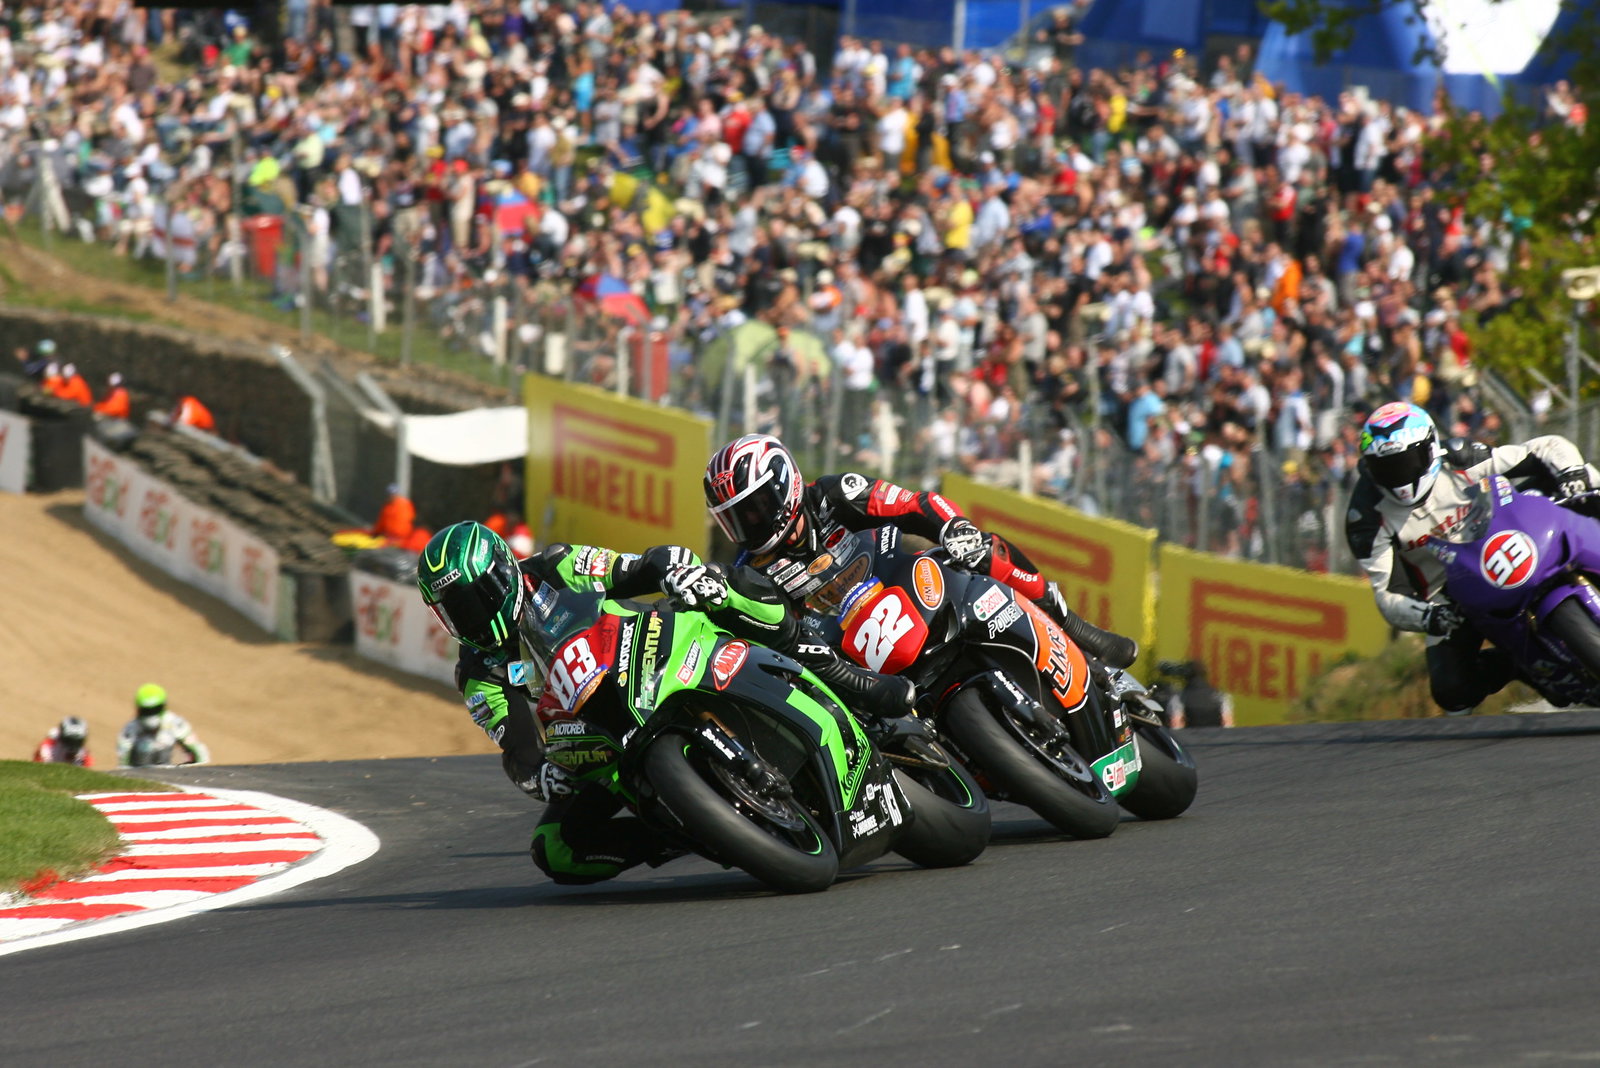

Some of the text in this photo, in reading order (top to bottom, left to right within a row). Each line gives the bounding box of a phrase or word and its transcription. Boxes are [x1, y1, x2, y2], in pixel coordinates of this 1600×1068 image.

[553, 401, 677, 533] PIRELLI
[880, 525, 891, 555] HITACHI
[1485, 531, 1532, 587] 33
[431, 569, 460, 590] SHARK
[981, 591, 1005, 614] Castrol
[618, 622, 635, 673] MOTOREX
[797, 643, 831, 655] TCX
[853, 594, 915, 674] 22
[1188, 577, 1347, 700] PIREL
[640, 616, 664, 711] MOMENTUM
[555, 723, 586, 735] MOTOREX
